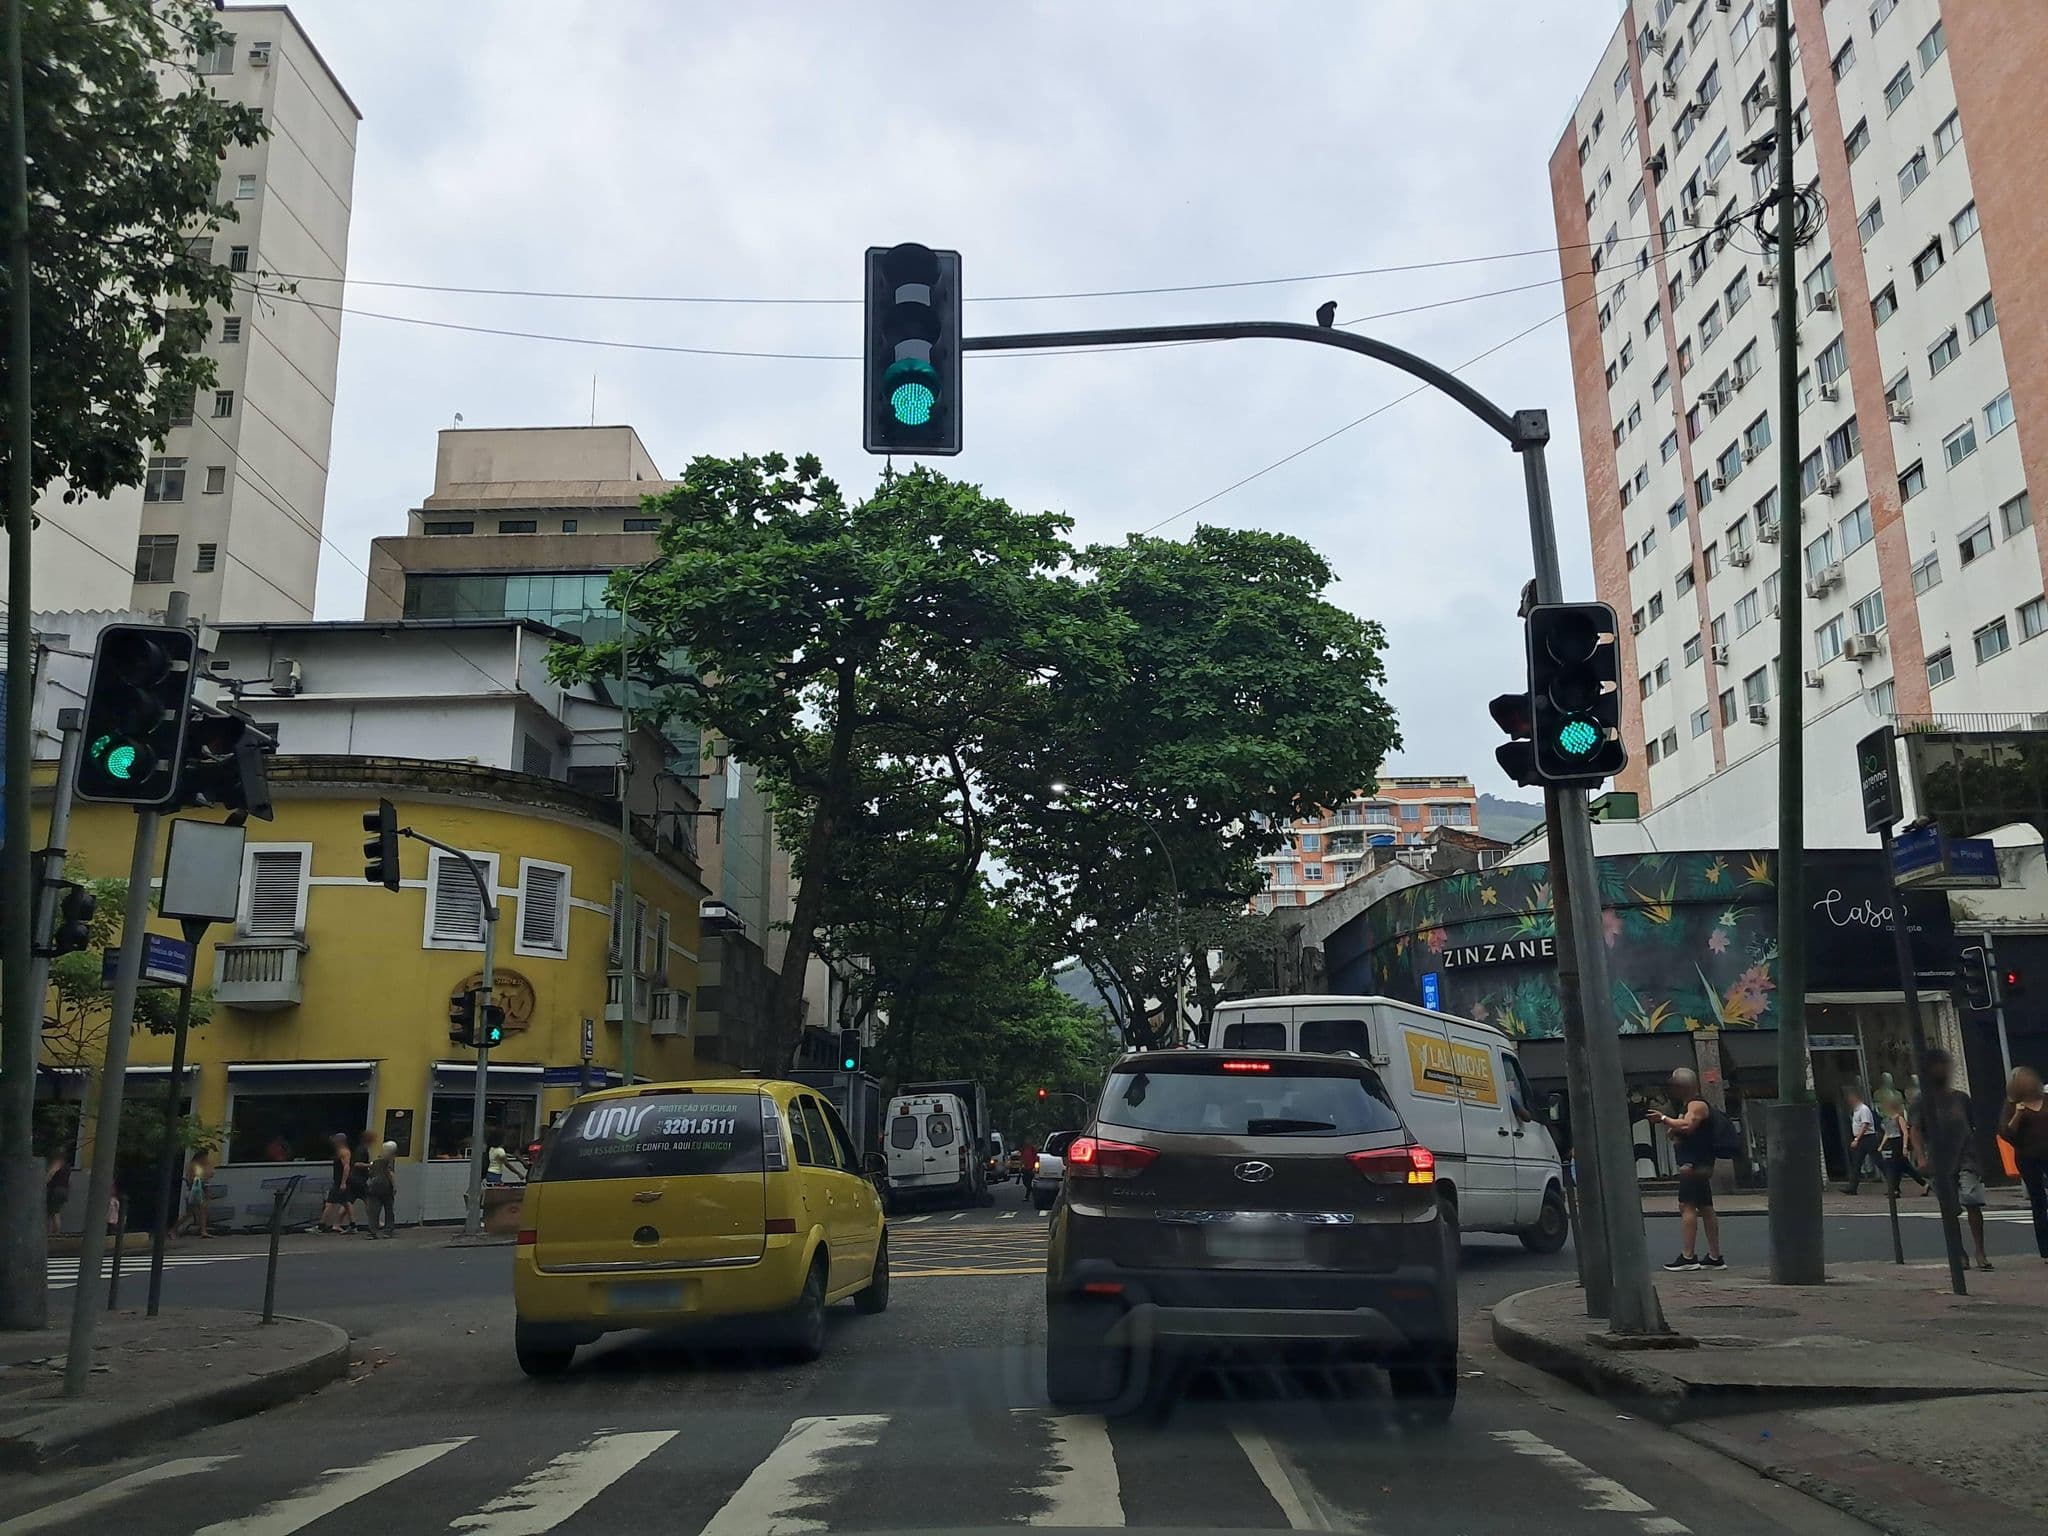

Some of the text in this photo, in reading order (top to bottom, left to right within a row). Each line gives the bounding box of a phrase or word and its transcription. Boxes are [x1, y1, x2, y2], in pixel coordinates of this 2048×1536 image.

[1443, 938, 1554, 968] ZINZANE
[699, 1104, 738, 1112] VEICULAR
[662, 1118, 735, 1135] 3281.6111
[673, 1142, 691, 1151] AQUI
